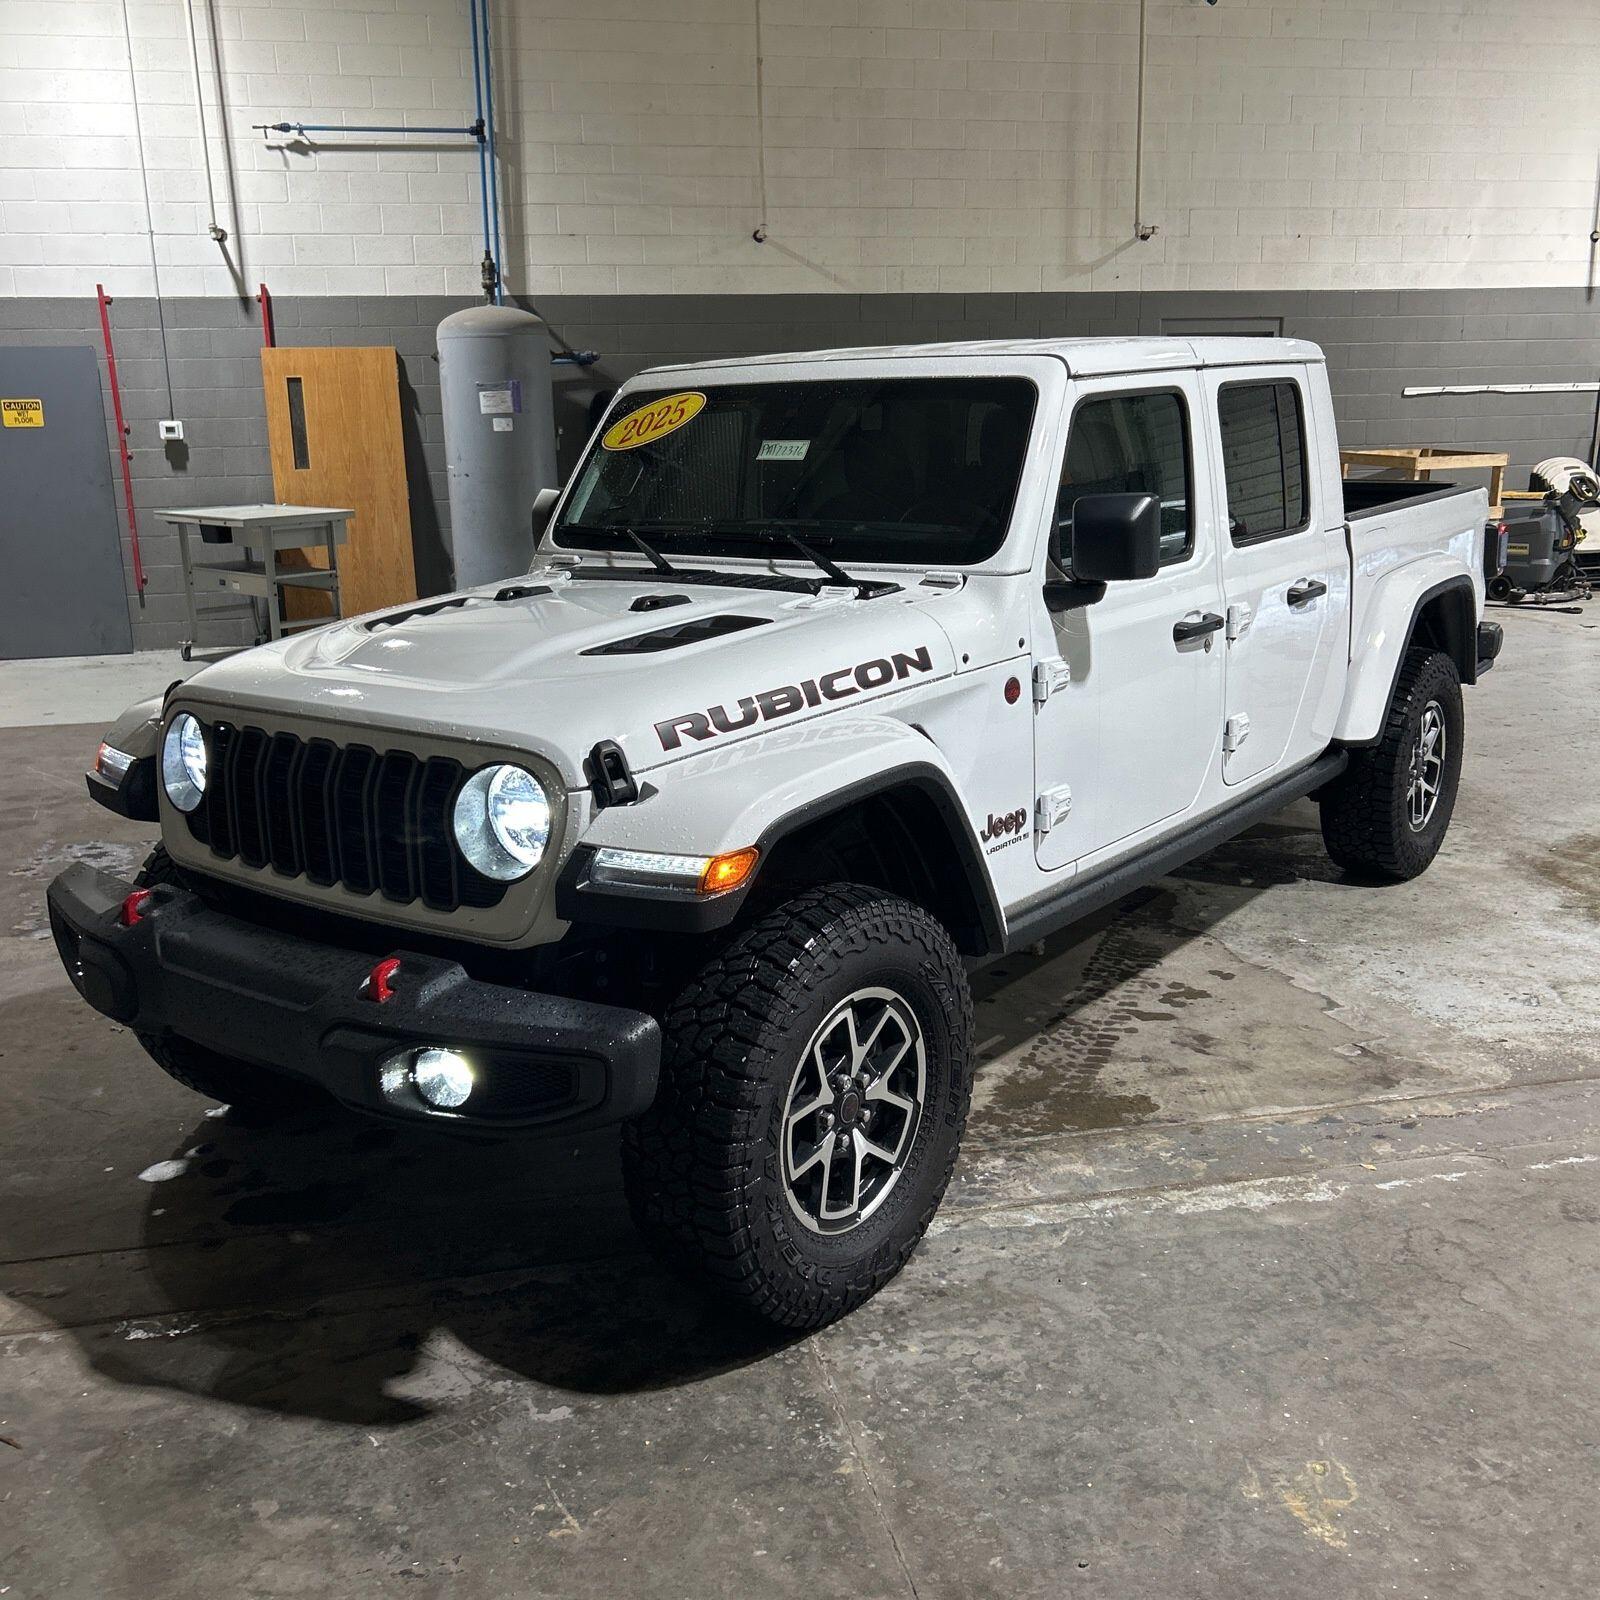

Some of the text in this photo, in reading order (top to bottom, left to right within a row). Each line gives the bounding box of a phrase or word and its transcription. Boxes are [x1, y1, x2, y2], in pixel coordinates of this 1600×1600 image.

[4, 402, 39, 410] CAUTION
[618, 398, 689, 445] 2025
[653, 646, 933, 752] RUBICON
[980, 808, 1027, 842] Jeep
[986, 835, 1022, 855] LADIATOR
